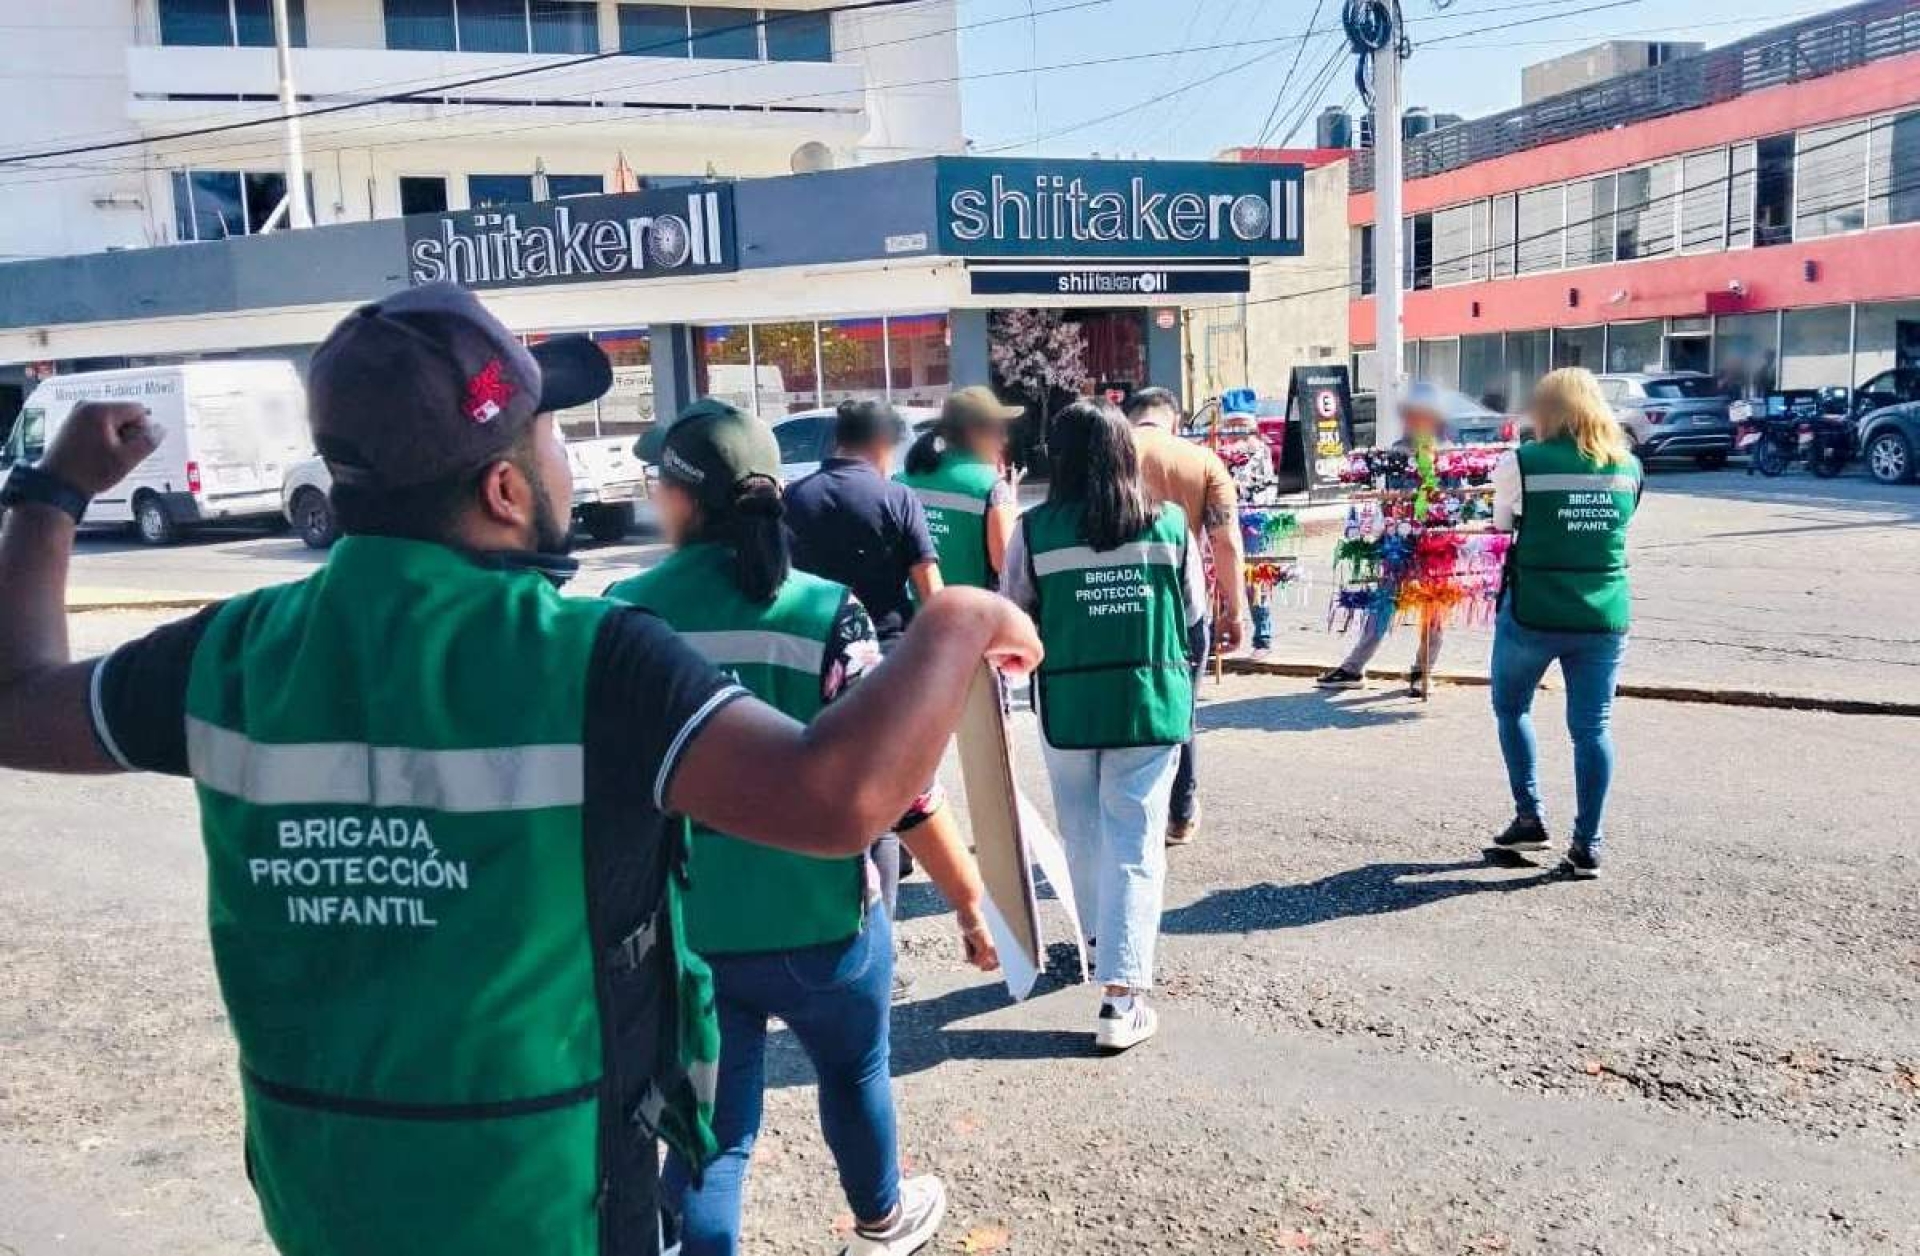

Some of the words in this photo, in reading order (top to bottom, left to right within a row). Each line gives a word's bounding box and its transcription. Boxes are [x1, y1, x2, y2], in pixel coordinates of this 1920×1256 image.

[951, 174, 1299, 242] shiitakeroll
[410, 192, 722, 285] shiitakeroll
[1567, 493, 1613, 504] BRIGADA
[1567, 521, 1609, 531] INFANTIL
[1085, 569, 1142, 584] BRIGADA
[1088, 602, 1145, 616] INFANTIL
[278, 817, 433, 849] BRIGADA
[249, 849, 469, 889] PROTECCIÓN
[287, 896, 438, 926] INFANTIL
